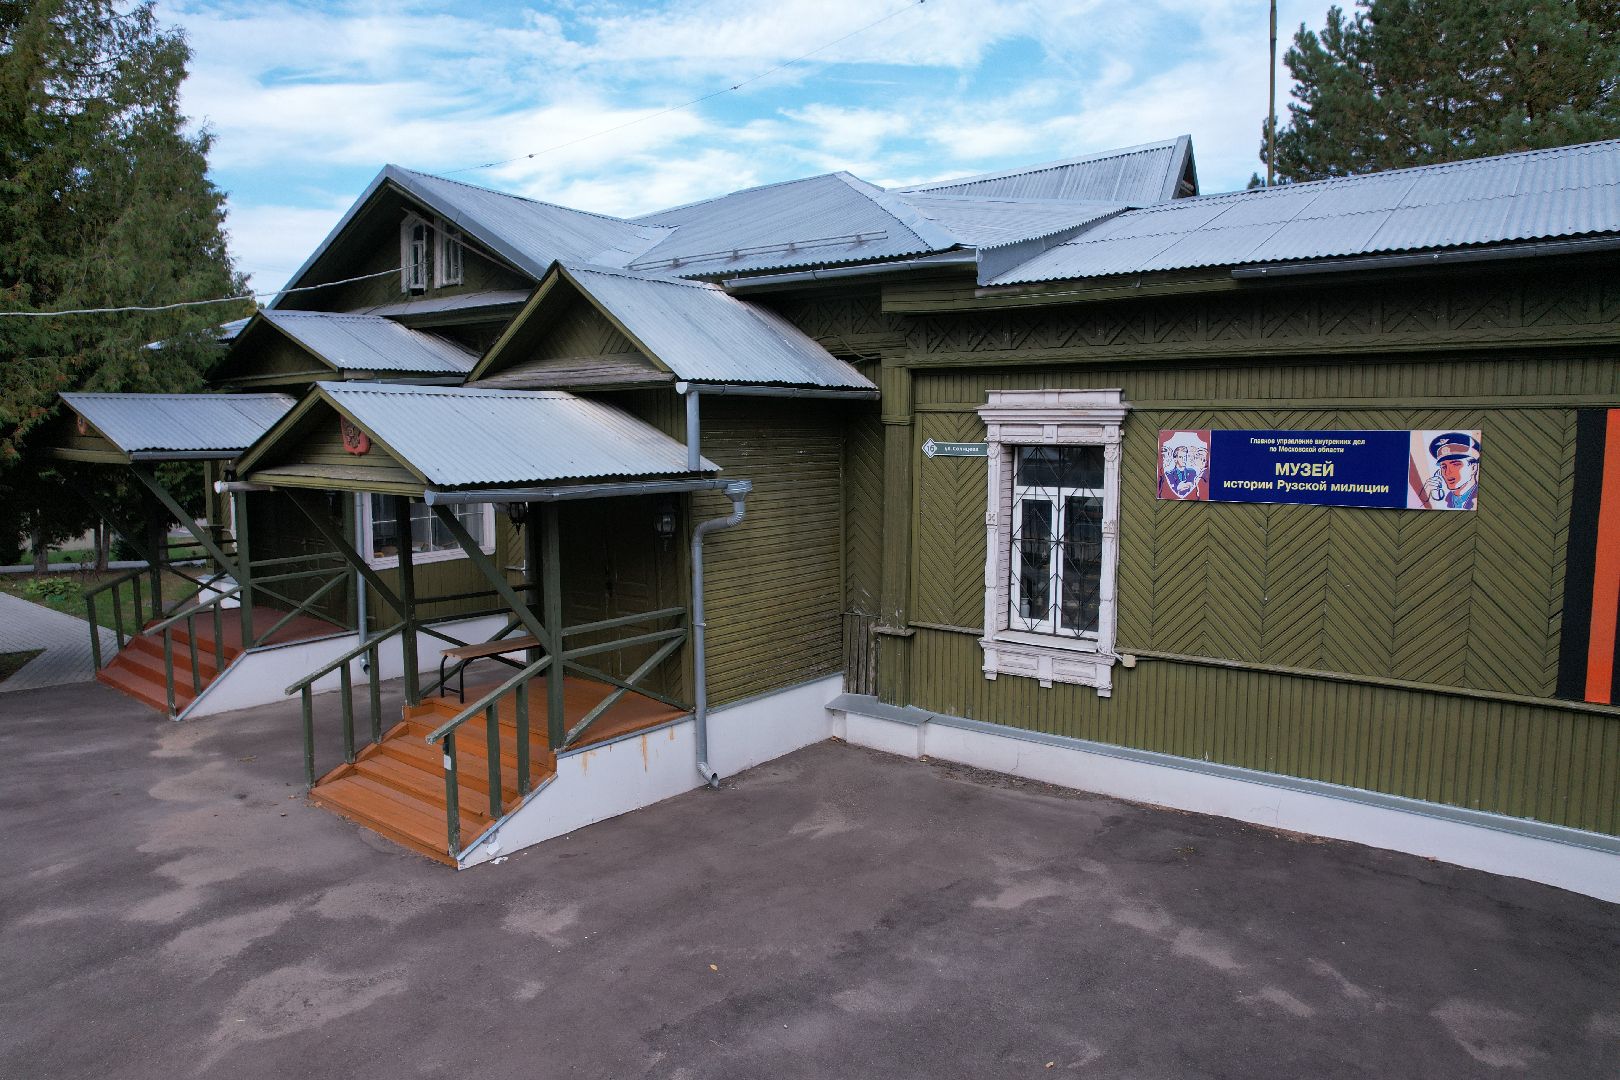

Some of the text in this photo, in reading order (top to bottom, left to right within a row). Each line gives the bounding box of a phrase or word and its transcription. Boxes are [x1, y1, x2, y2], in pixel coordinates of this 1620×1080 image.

[1250, 437, 1275, 445] Главное
[1276, 438, 1313, 446] управление
[1314, 438, 1352, 447] внутренних
[1317, 446, 1345, 454] области
[1275, 460, 1335, 477] МУЗЕЙ
[1223, 480, 1389, 494] истории Рузской милиции
